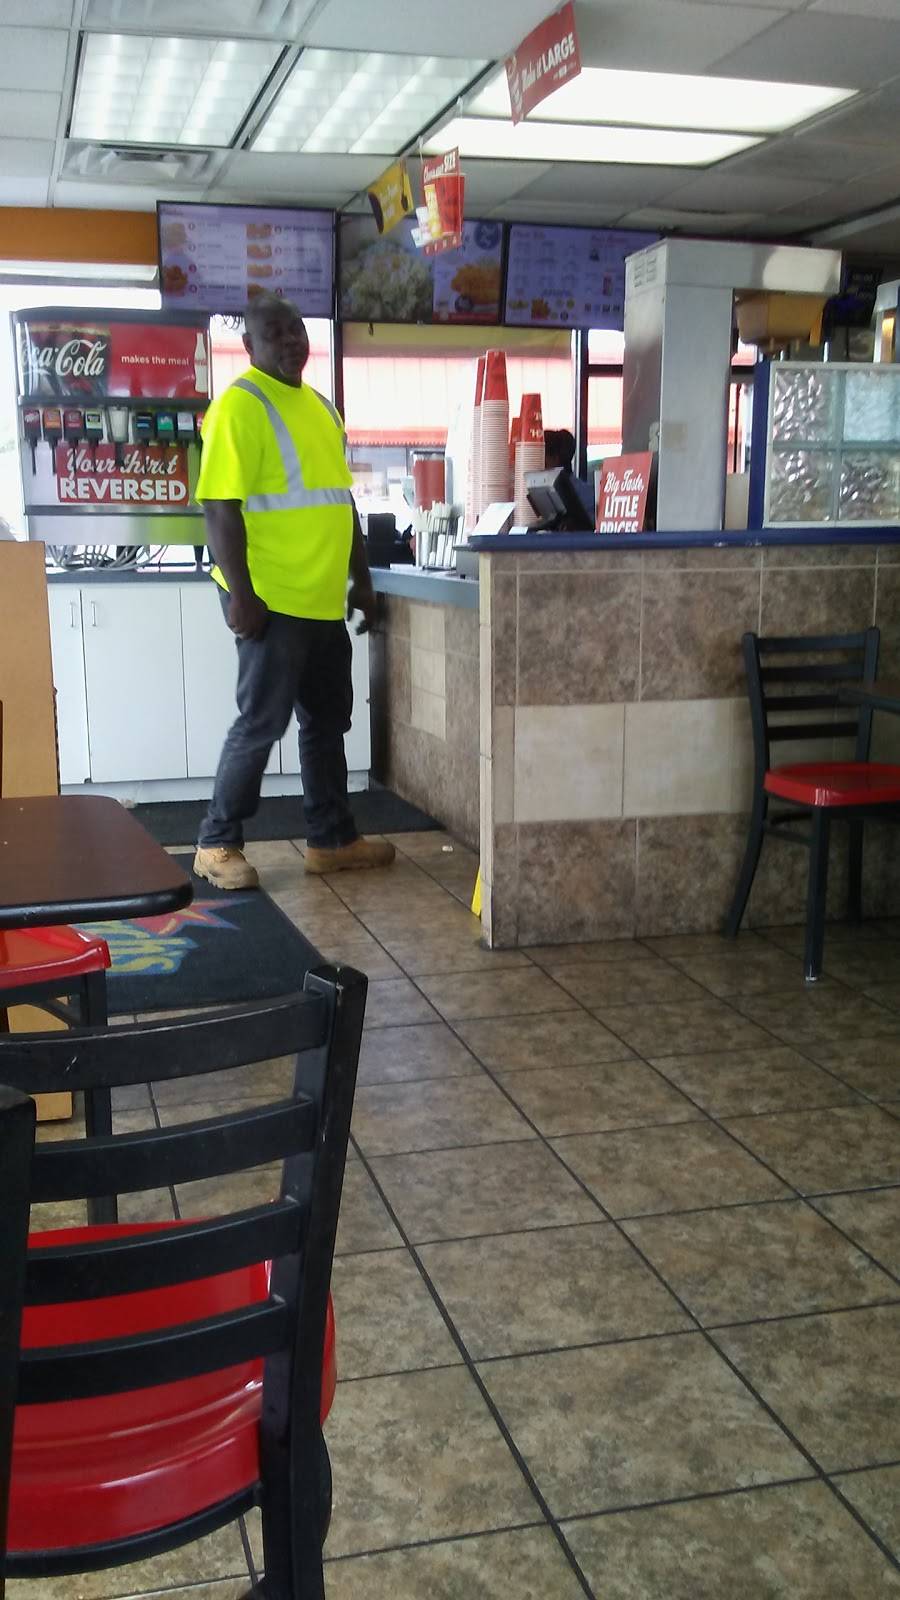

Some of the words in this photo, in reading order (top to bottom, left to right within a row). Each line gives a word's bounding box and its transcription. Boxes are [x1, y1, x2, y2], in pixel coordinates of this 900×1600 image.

[542, 32, 576, 74] LARGE
[121, 355, 150, 364] makes
[151, 355, 166, 365] the
[168, 357, 189, 365] meal
[67, 448, 116, 480] Your
[60, 478, 187, 501] REVERSED
[604, 471, 619, 497] Big
[604, 495, 639, 518] LITTLE
